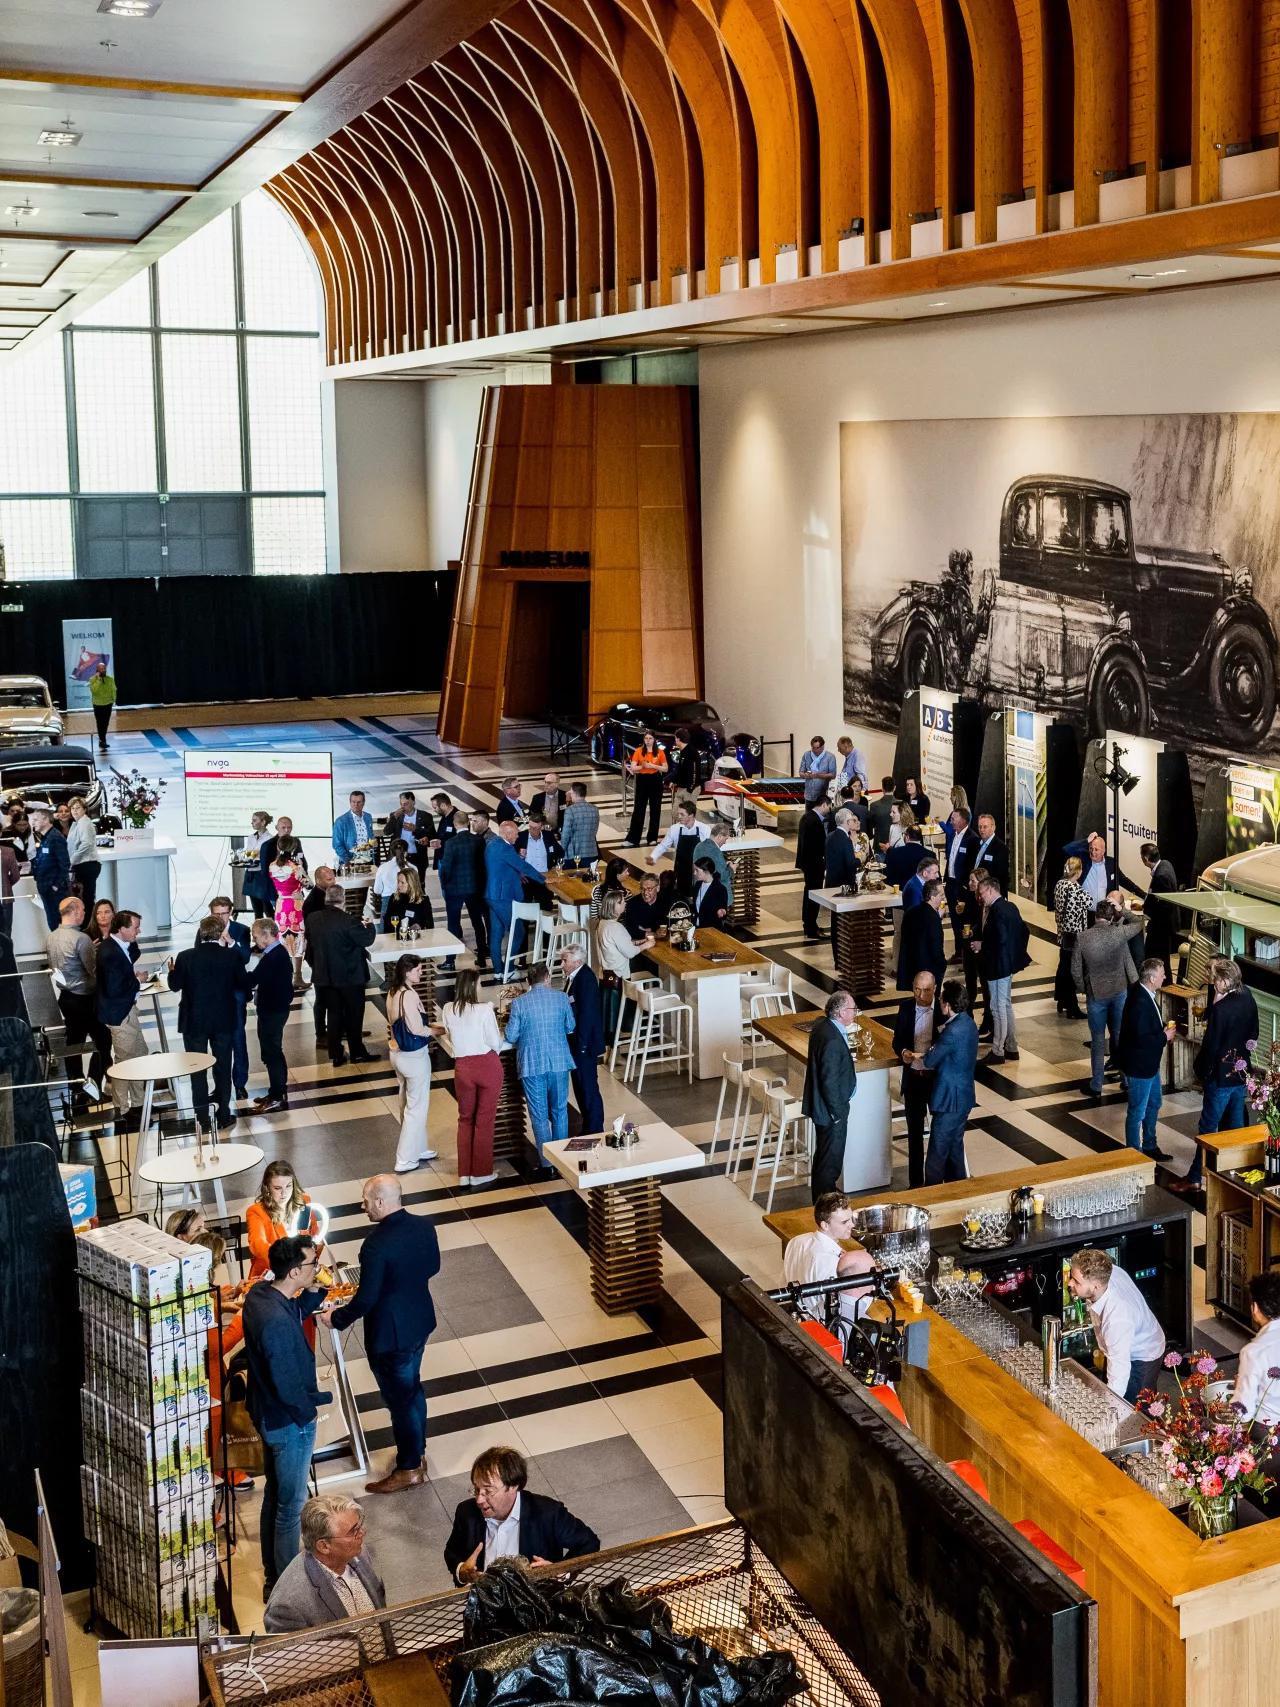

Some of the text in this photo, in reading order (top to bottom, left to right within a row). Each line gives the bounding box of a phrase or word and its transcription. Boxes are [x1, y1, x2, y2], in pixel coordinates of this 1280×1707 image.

[71, 632, 105, 640] WELKOM
[207, 759, 229, 769] nvga
[1234, 802, 1261, 818] samen!
